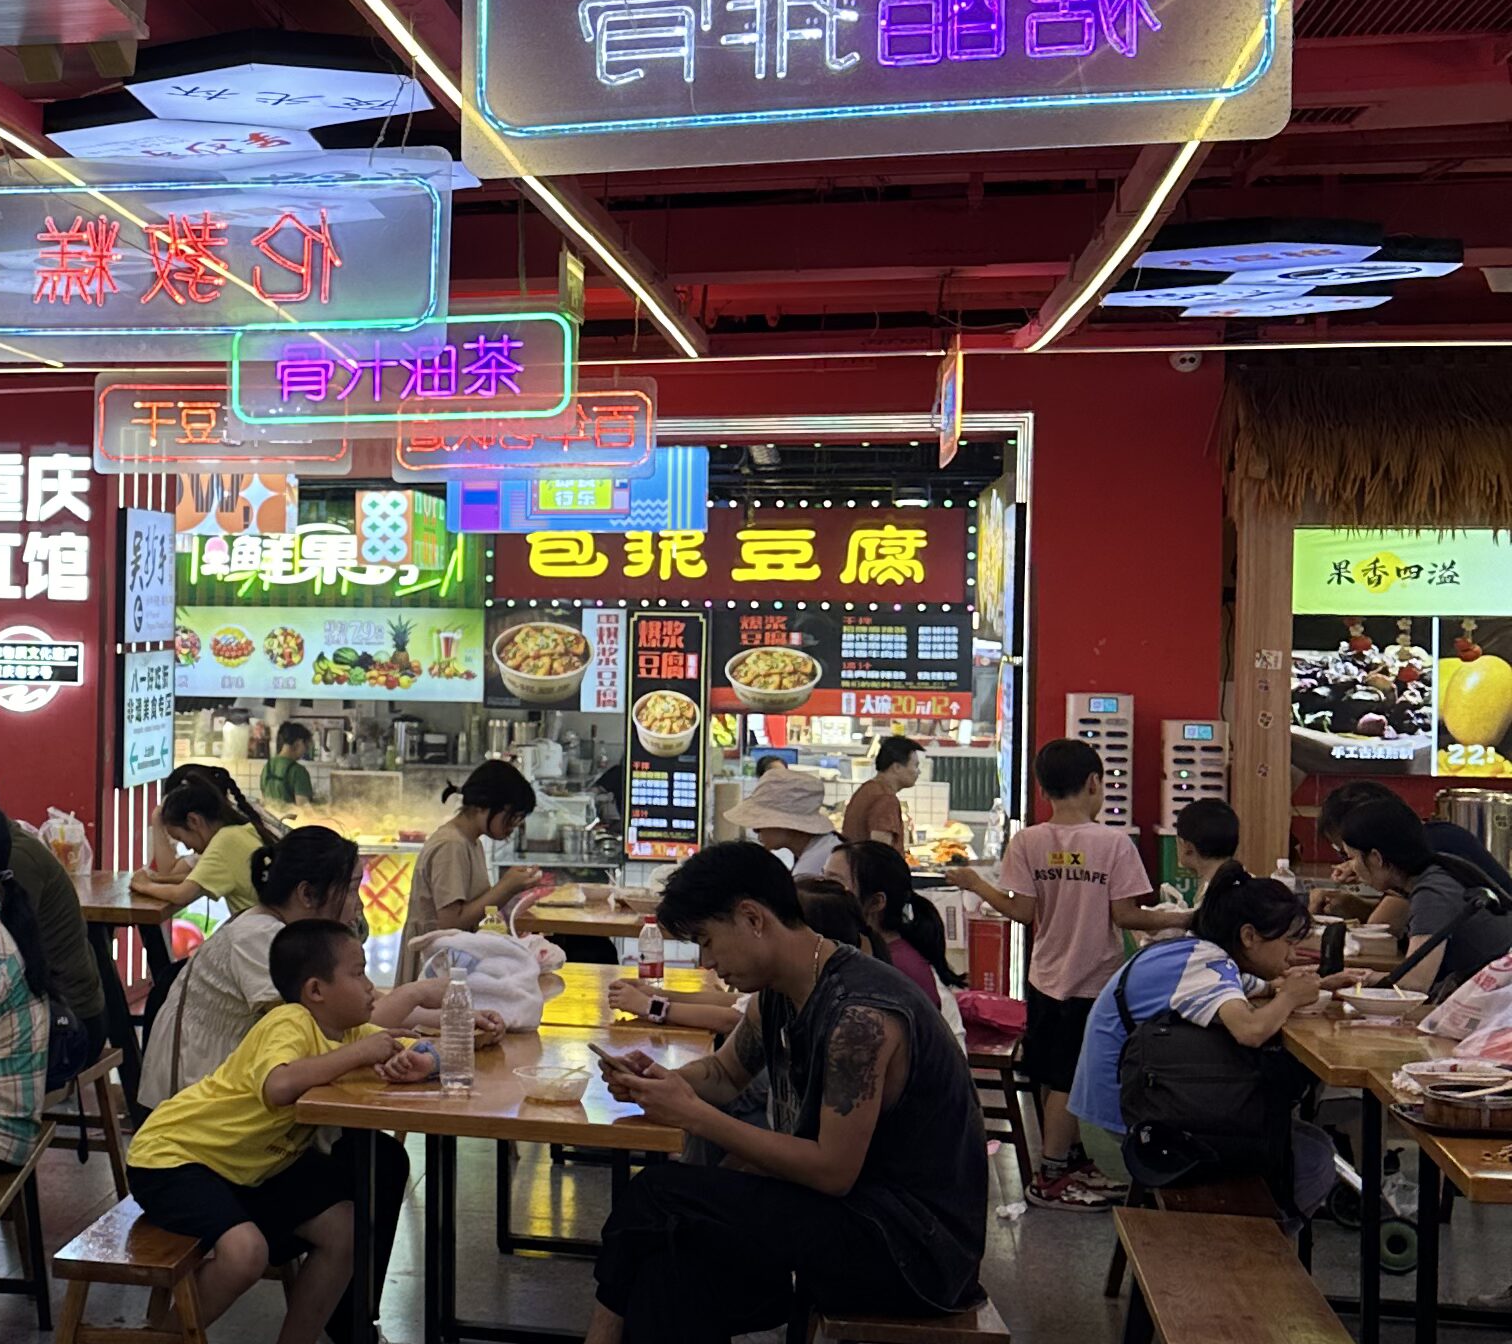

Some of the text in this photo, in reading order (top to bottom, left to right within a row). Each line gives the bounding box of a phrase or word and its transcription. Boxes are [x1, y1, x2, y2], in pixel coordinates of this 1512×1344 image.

[275, 334, 525, 403] 骨汁油茶
[1327, 557, 1460, 587] 果香四溢
[638, 651, 685, 679] 豆腐
